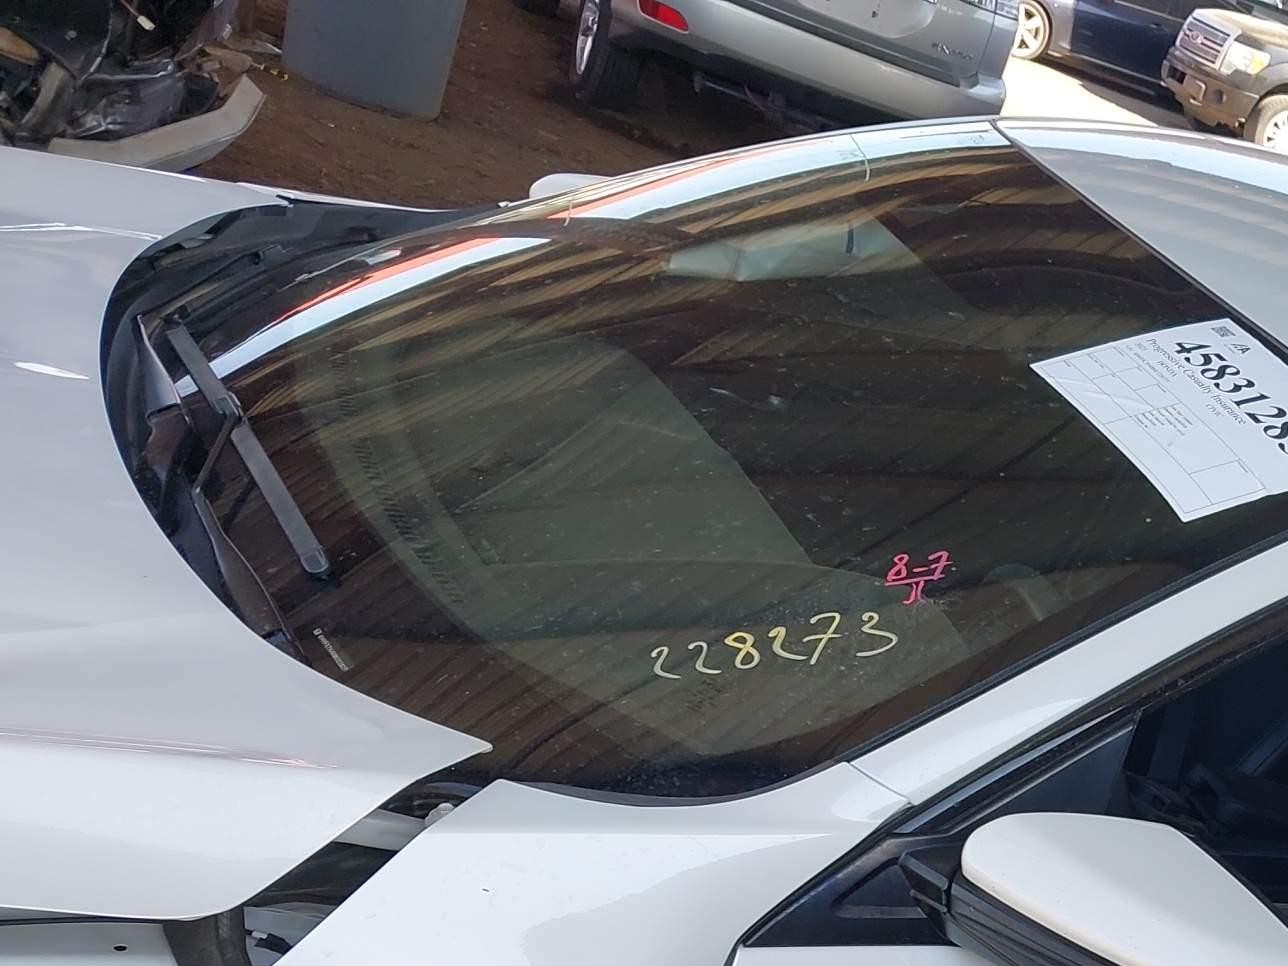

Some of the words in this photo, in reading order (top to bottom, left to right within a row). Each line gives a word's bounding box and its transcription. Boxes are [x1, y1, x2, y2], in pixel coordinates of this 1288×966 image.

[1145, 338, 1186, 370] Progressive
[1182, 369, 1213, 394] Casualty
[1210, 394, 1247, 424] Insurance
[886, 550, 953, 582] 8-7
[650, 611, 899, 680] 228273
